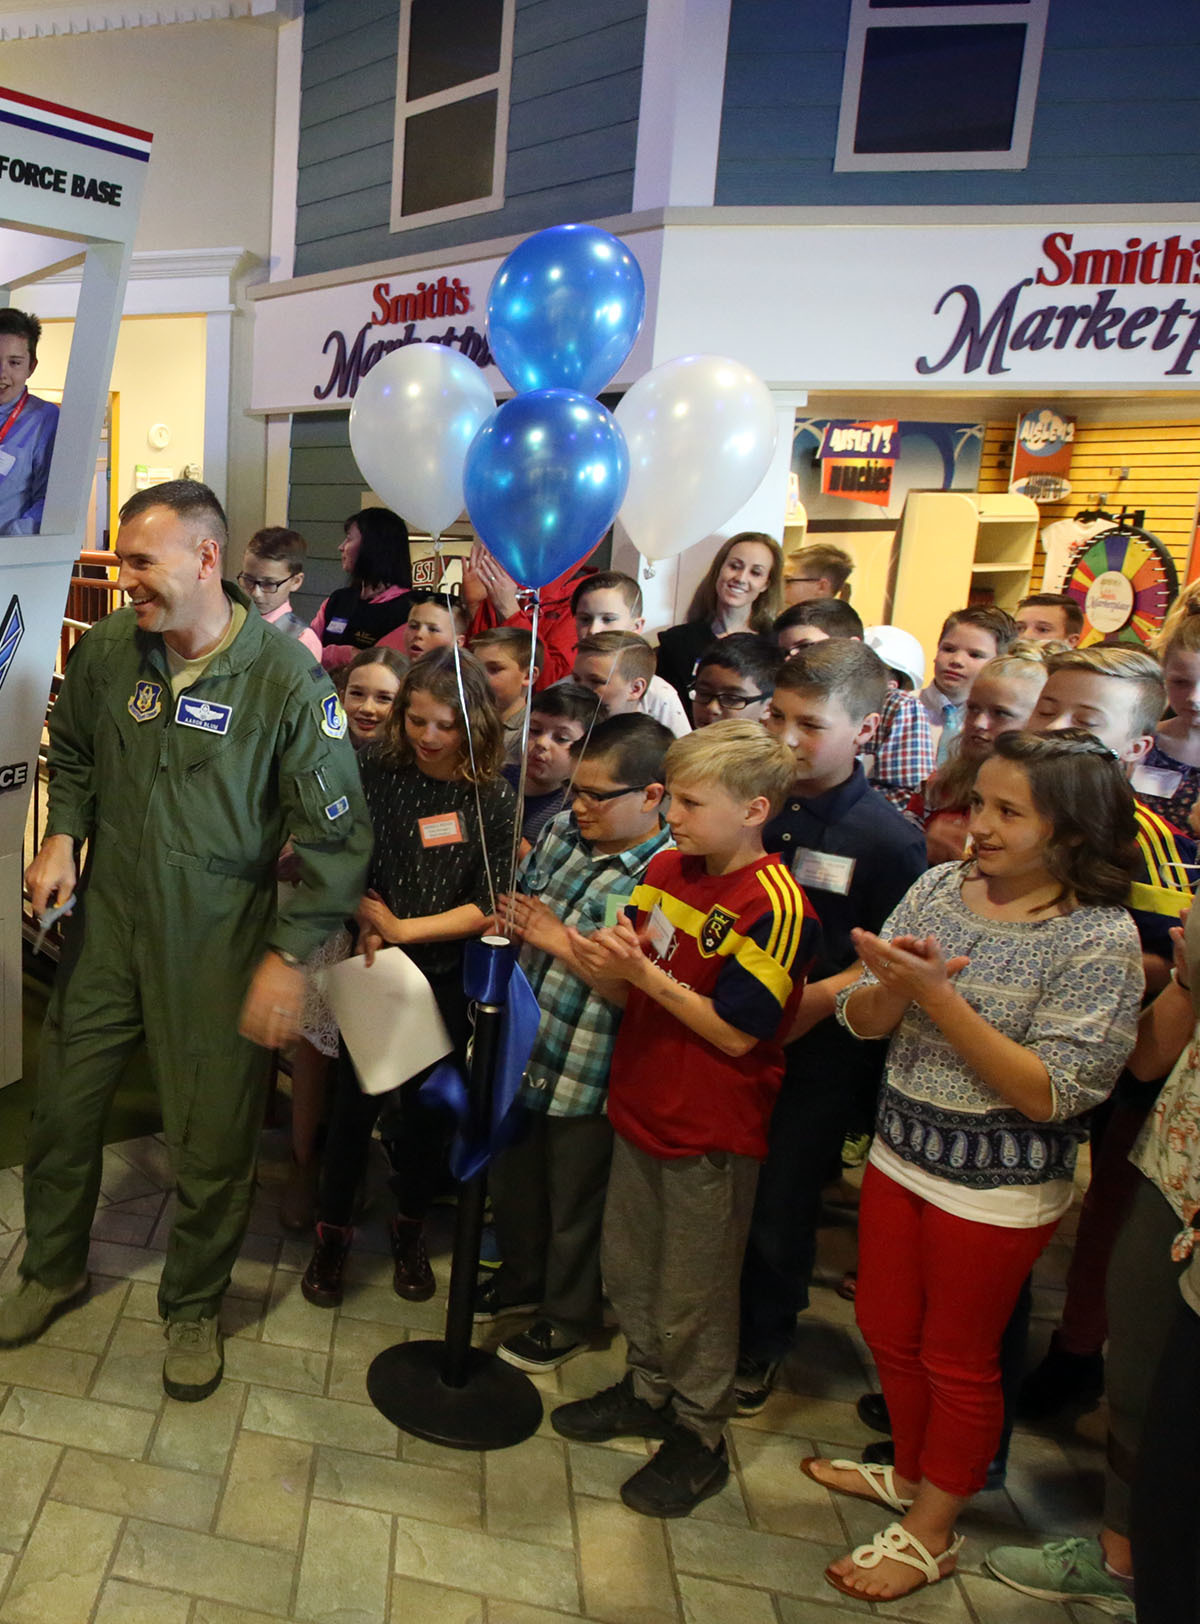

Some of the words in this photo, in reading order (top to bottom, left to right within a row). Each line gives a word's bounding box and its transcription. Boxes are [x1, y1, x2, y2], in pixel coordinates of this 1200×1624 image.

[71, 174, 123, 207] BASE
[371, 276, 471, 326] Smith's
[184, 717, 203, 726] AARON
